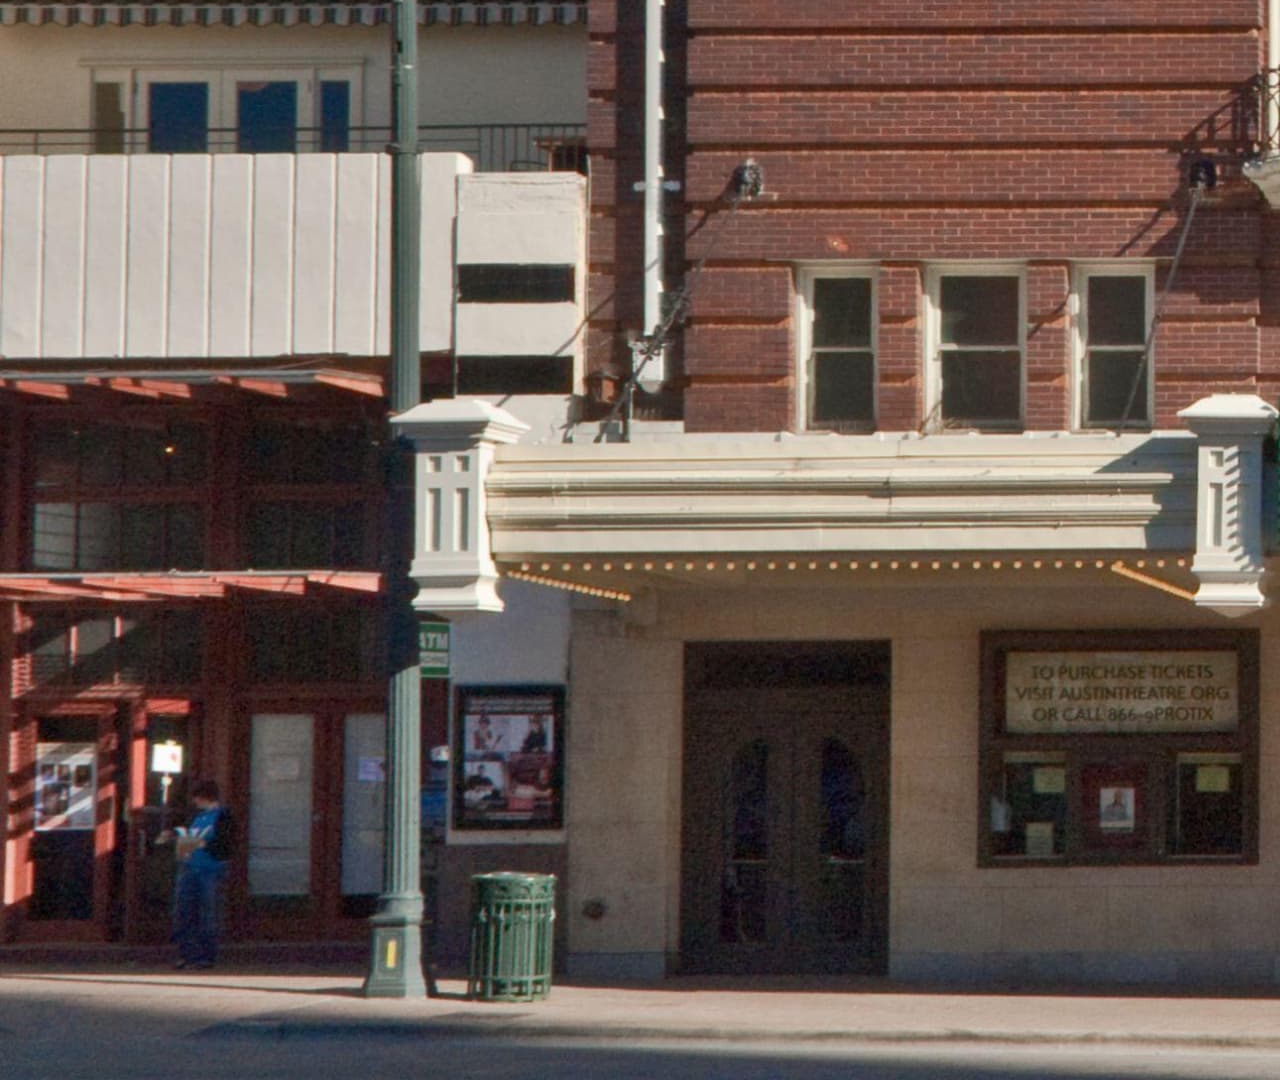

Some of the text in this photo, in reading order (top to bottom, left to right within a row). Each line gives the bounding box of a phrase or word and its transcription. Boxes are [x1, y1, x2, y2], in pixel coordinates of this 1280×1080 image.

[1032, 664, 1215, 681] TO PURCHASE TICKETS
[1016, 686, 1054, 701] VISIT
[1032, 706, 1058, 722] OR
[1062, 706, 1106, 722] CALL
